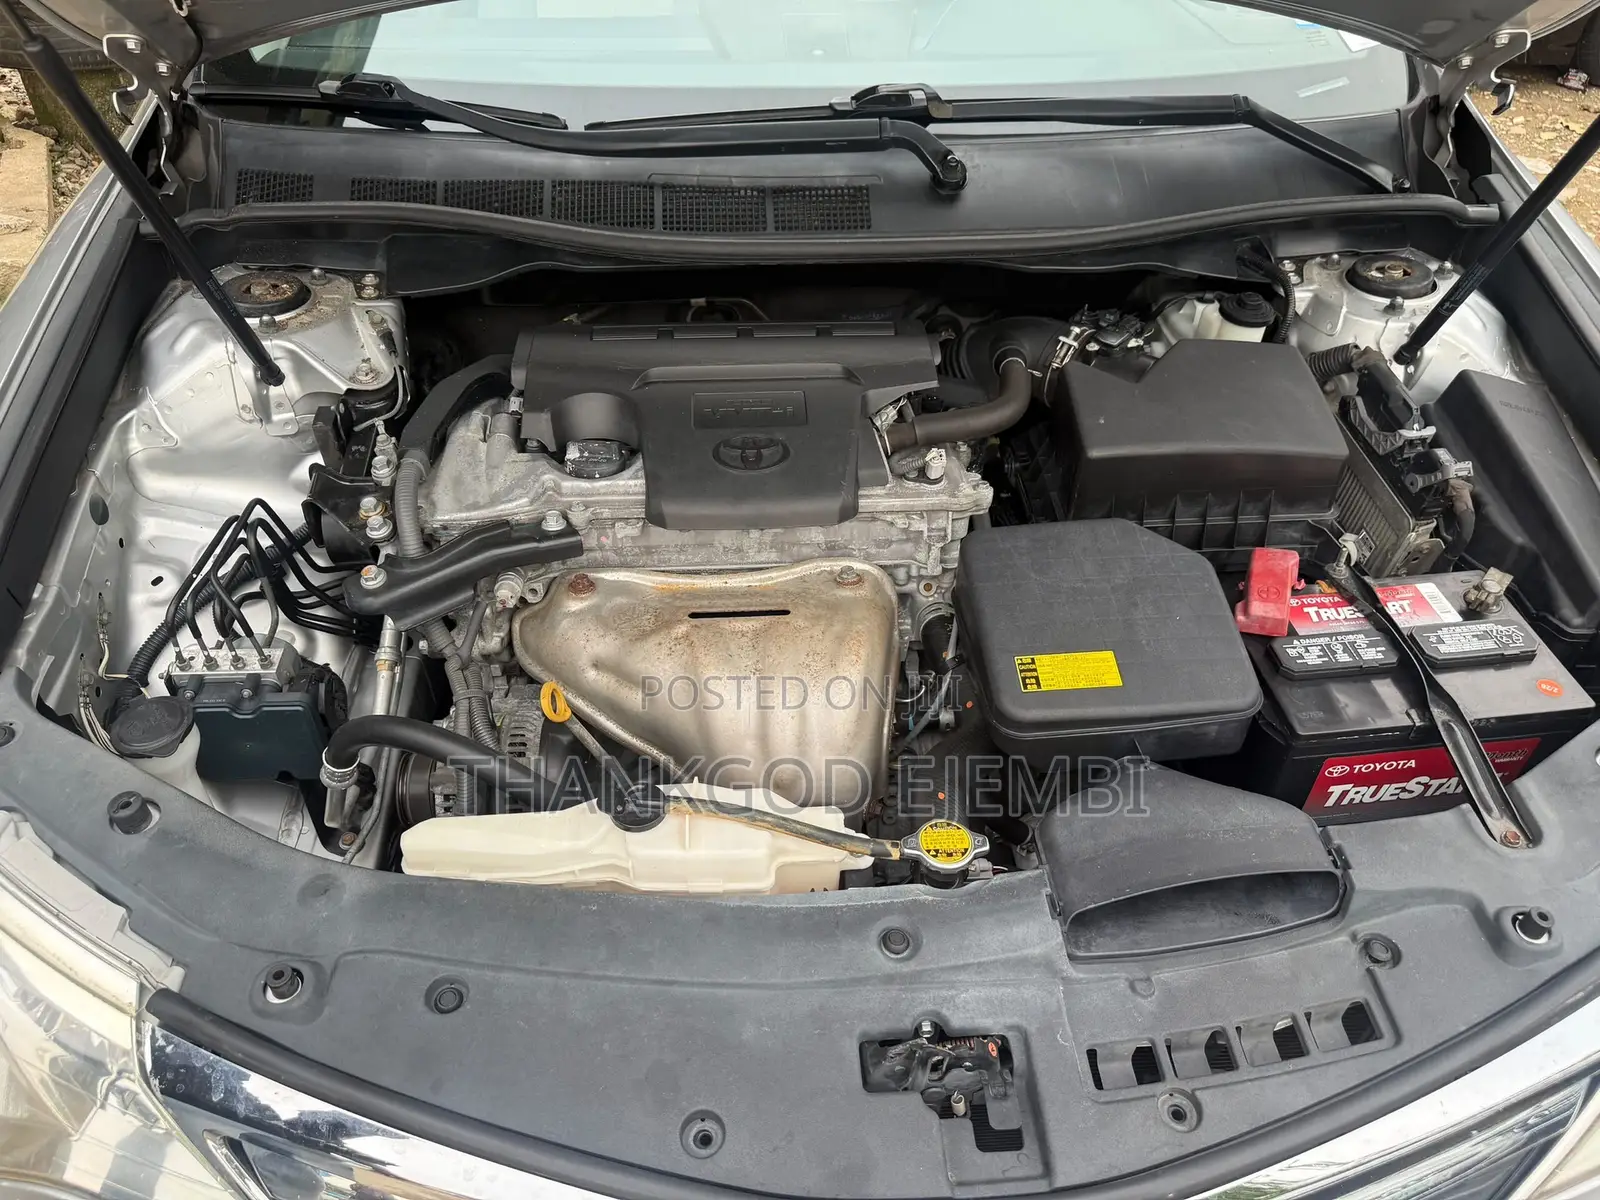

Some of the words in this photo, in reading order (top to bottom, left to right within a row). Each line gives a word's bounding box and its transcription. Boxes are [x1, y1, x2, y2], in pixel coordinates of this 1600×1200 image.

[1301, 596, 1342, 605] TOYOTA
[1300, 636, 1332, 645] DANGER
[1336, 633, 1366, 642] POISON
[1353, 759, 1416, 774] TOYOTA
